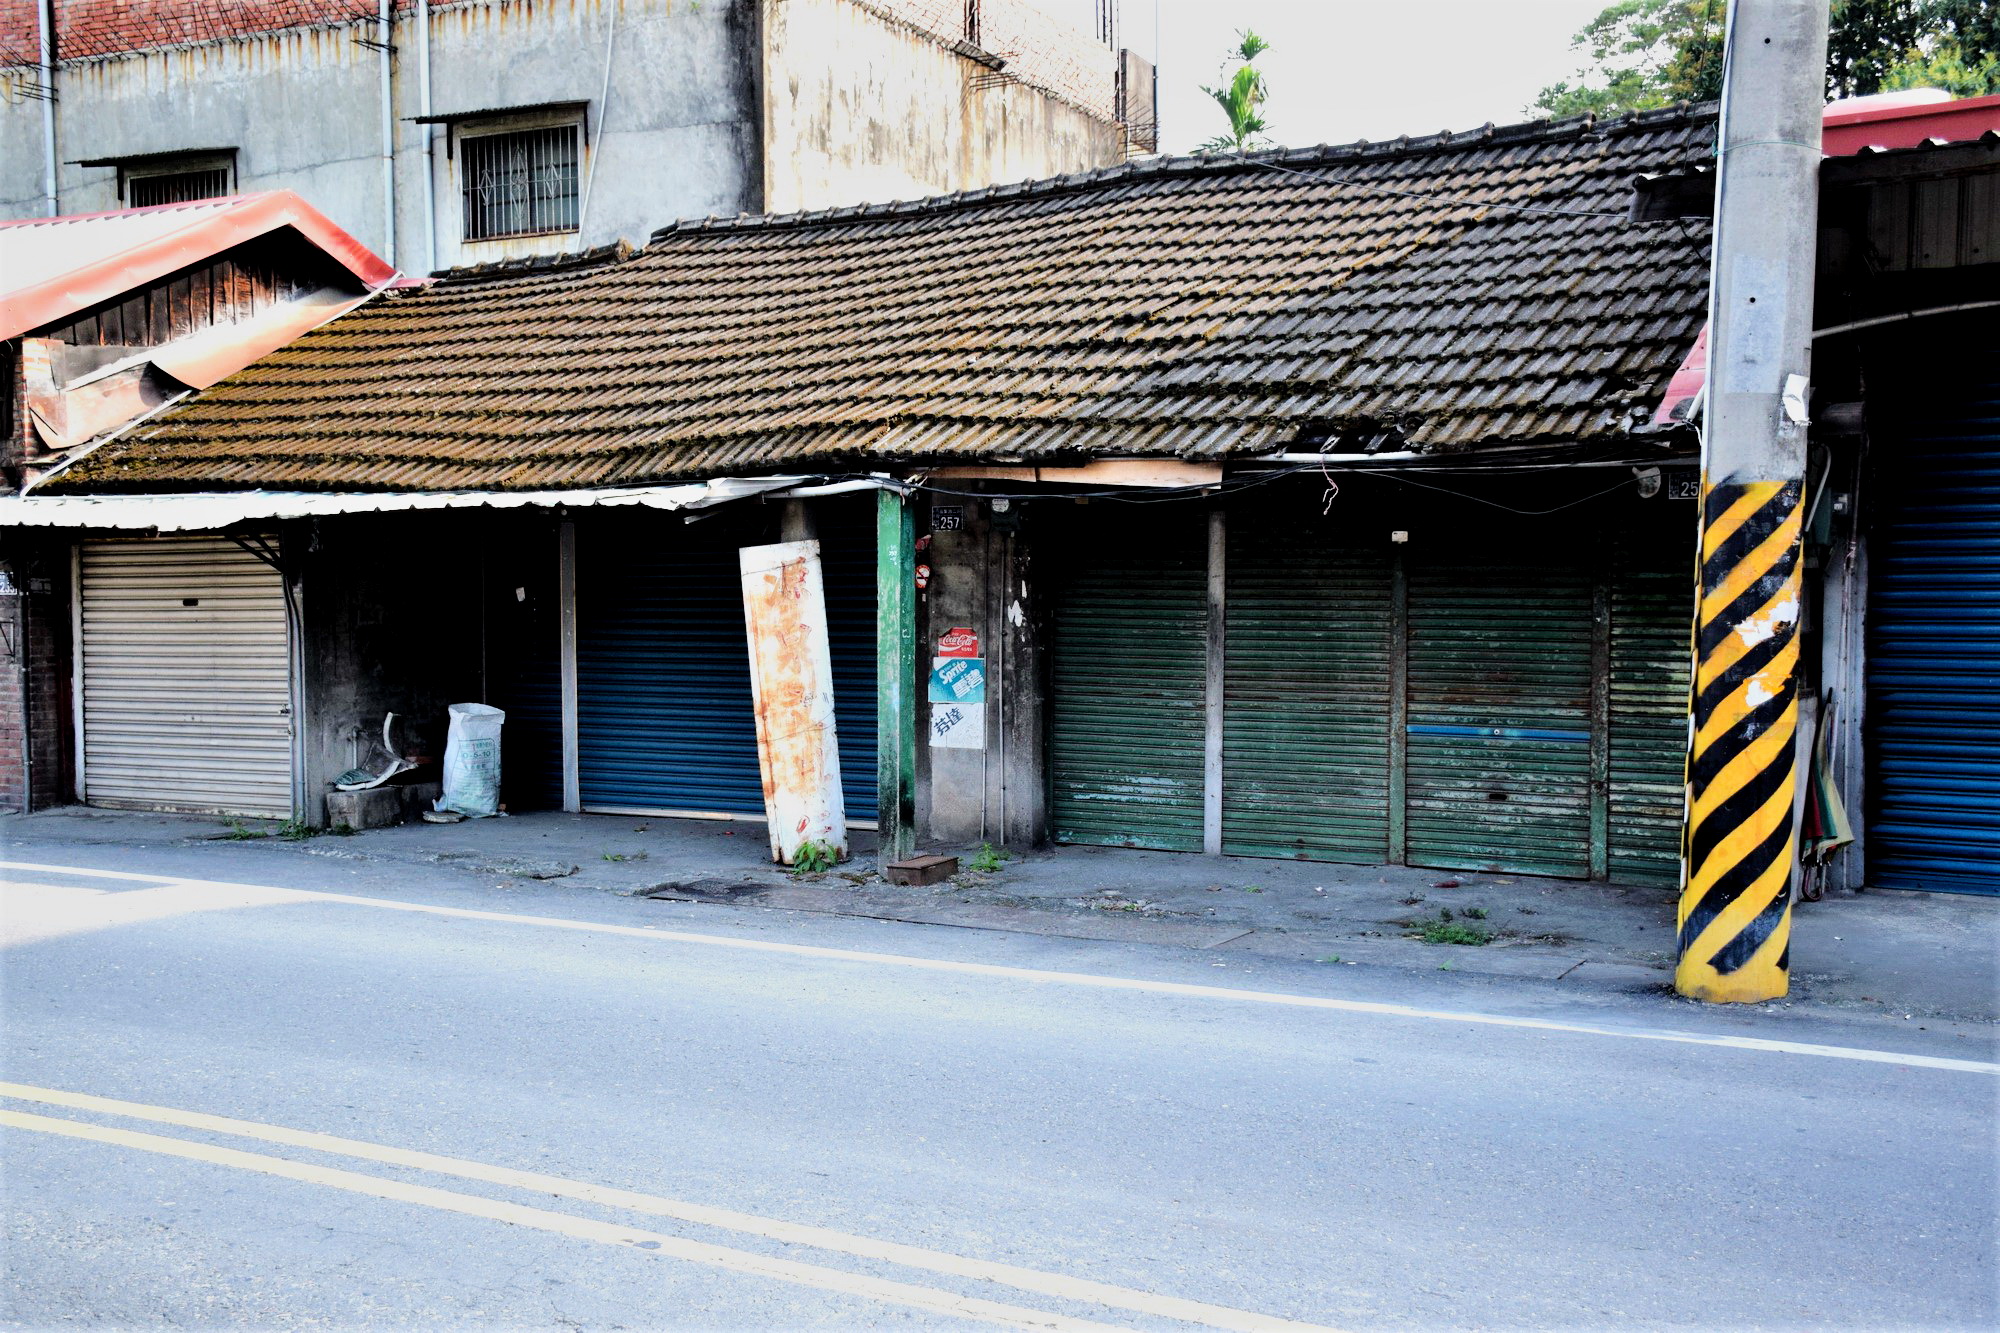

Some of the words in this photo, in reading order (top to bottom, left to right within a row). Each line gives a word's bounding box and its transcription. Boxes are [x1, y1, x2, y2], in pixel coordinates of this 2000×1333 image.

[1681, 481, 1699, 497] 25
[940, 516, 960, 529] 257
[938, 660, 968, 685] Sprite
[951, 668, 985, 699] 雪碧
[933, 707, 964, 737] 芬達
